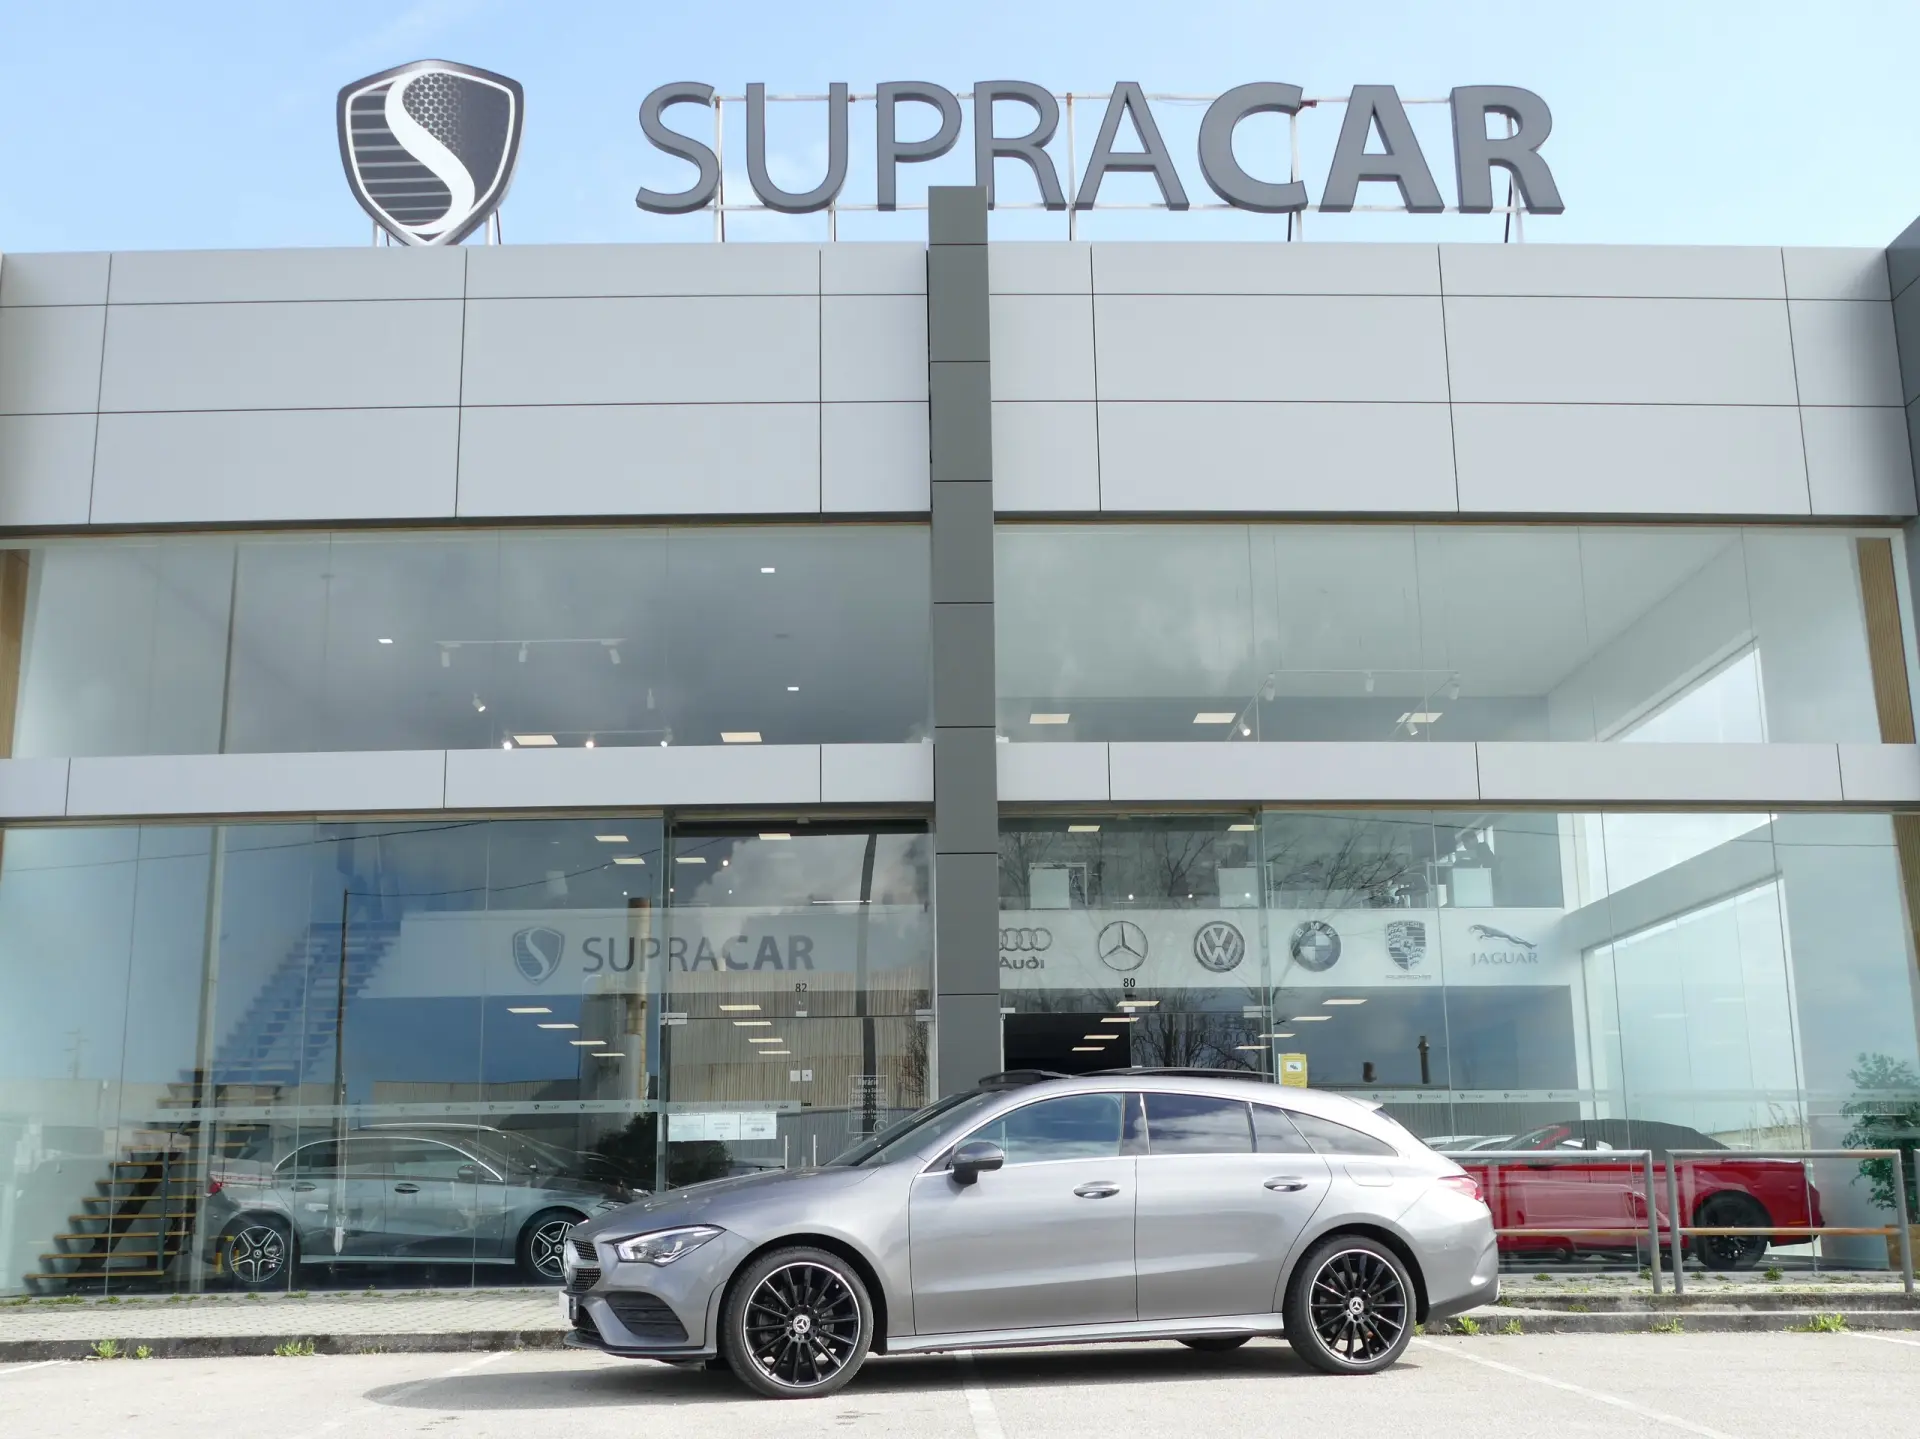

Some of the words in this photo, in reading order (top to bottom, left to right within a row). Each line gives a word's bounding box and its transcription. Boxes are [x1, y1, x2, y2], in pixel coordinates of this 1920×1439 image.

[635, 80, 1566, 215] SUPRACAR
[1295, 922, 1336, 938] BMW
[582, 935, 815, 972] SUPRACAR
[1471, 952, 1538, 967] JAGUAR
[999, 956, 1045, 969] Audi
[795, 982, 807, 993] 82
[1123, 978, 1136, 988] 80
